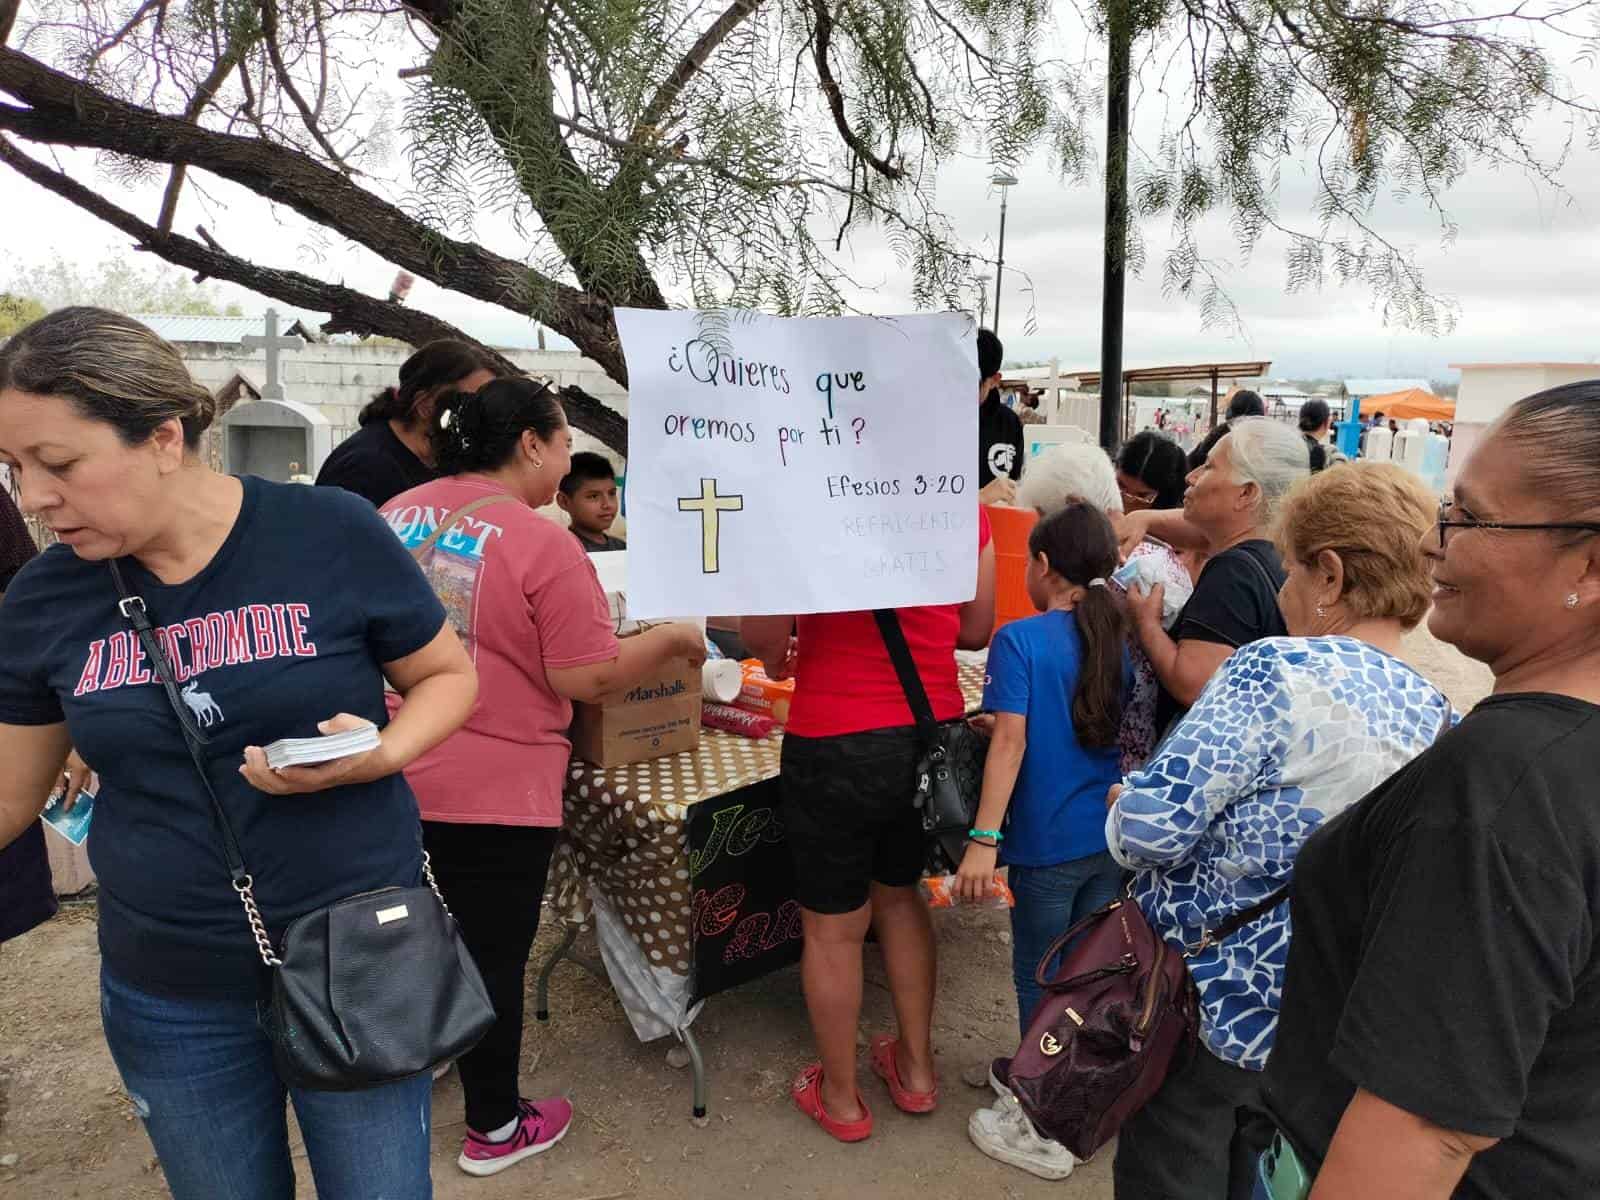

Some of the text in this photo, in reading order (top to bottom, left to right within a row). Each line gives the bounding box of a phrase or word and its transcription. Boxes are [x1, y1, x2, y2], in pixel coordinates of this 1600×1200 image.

[668, 338, 867, 419] ¿Quieres que
[664, 413, 755, 444] oremos
[778, 427, 805, 467] por
[826, 473, 966, 498] Efesios 3:20
